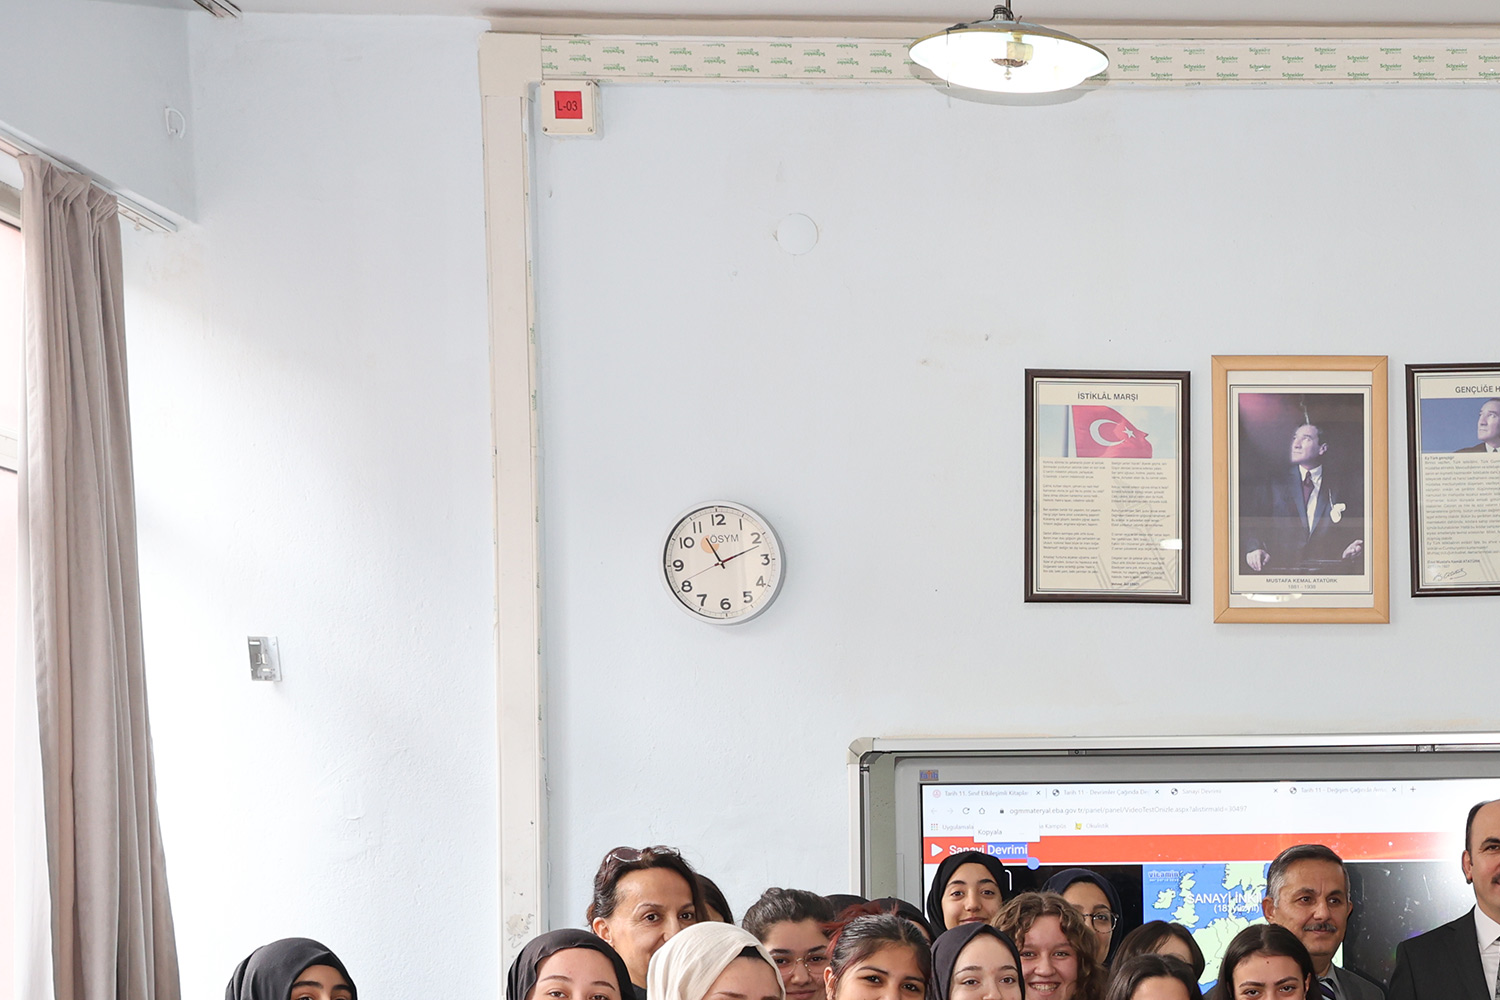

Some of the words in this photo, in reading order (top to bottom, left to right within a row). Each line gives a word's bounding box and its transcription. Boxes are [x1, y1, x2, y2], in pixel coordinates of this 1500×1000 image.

[557, 100, 578, 111] L-03
[1455, 384, 1493, 394] GENÇLİĞE
[1077, 392, 1110, 400] İSTİKLÂL
[1113, 394, 1139, 402] MARŞI
[711, 514, 727, 526] 12
[739, 518, 743, 531] 1
[693, 521, 702, 534] 11
[679, 536, 695, 549] 10
[750, 532, 761, 544] 2
[673, 559, 684, 572] 9
[760, 554, 770, 566] 3
[681, 580, 693, 593] 8
[756, 576, 766, 588] 4
[697, 594, 707, 607] 7
[743, 591, 753, 603] 5
[720, 598, 731, 610] 6
[978, 829, 1002, 837] Kopyala
[987, 845, 1028, 854] Devrimi
[1186, 891, 1231, 904] SANAYİ
